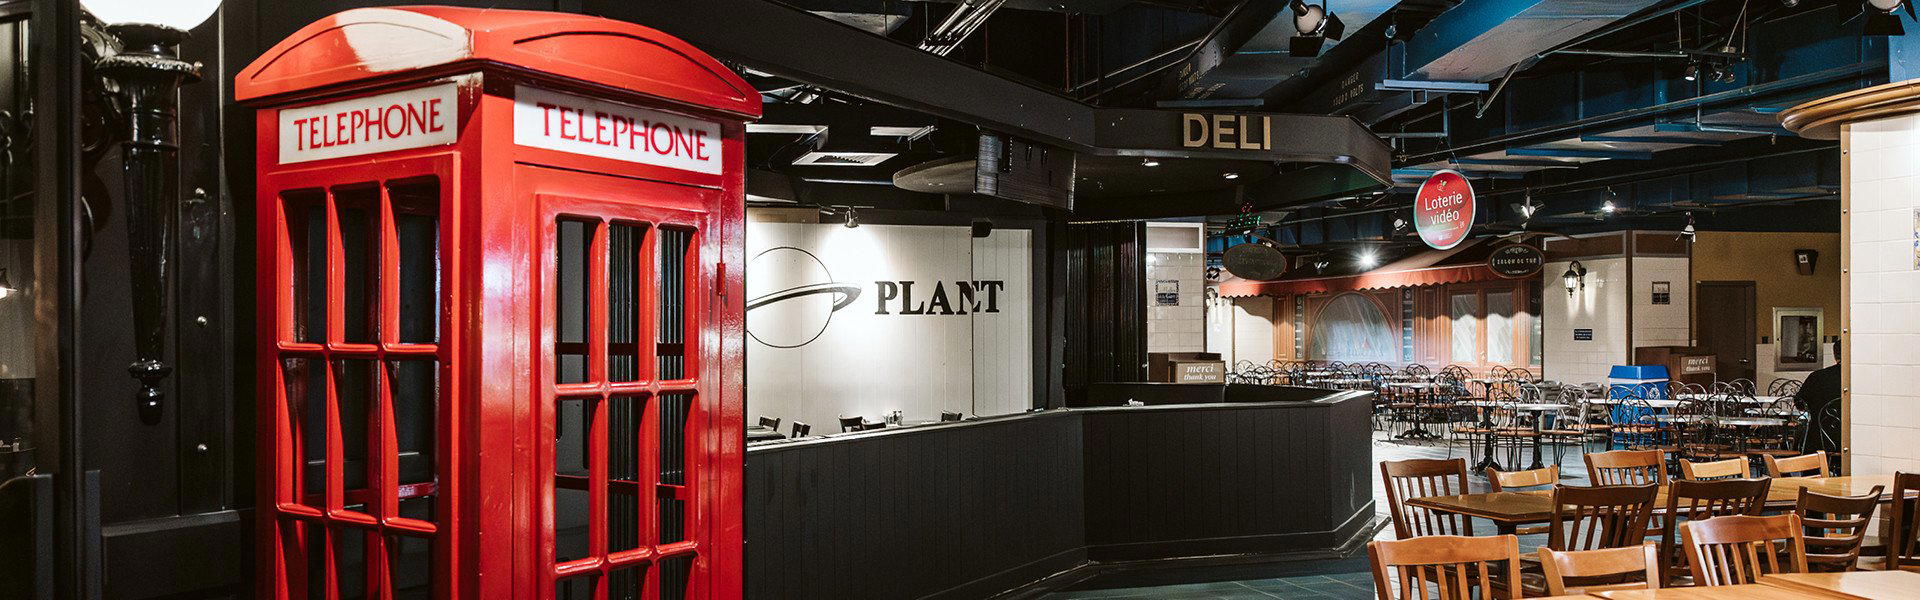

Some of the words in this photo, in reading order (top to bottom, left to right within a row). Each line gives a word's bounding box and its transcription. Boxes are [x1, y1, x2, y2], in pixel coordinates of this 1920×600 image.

[293, 98, 444, 151] TELEPHONE
[536, 102, 710, 162] TELEPHONE
[1182, 113, 1271, 150] DELI
[1424, 191, 1463, 211] Loterie
[1429, 208, 1460, 225] vidéo
[1184, 373, 1203, 381] thank
[1187, 363, 1214, 373] merci
